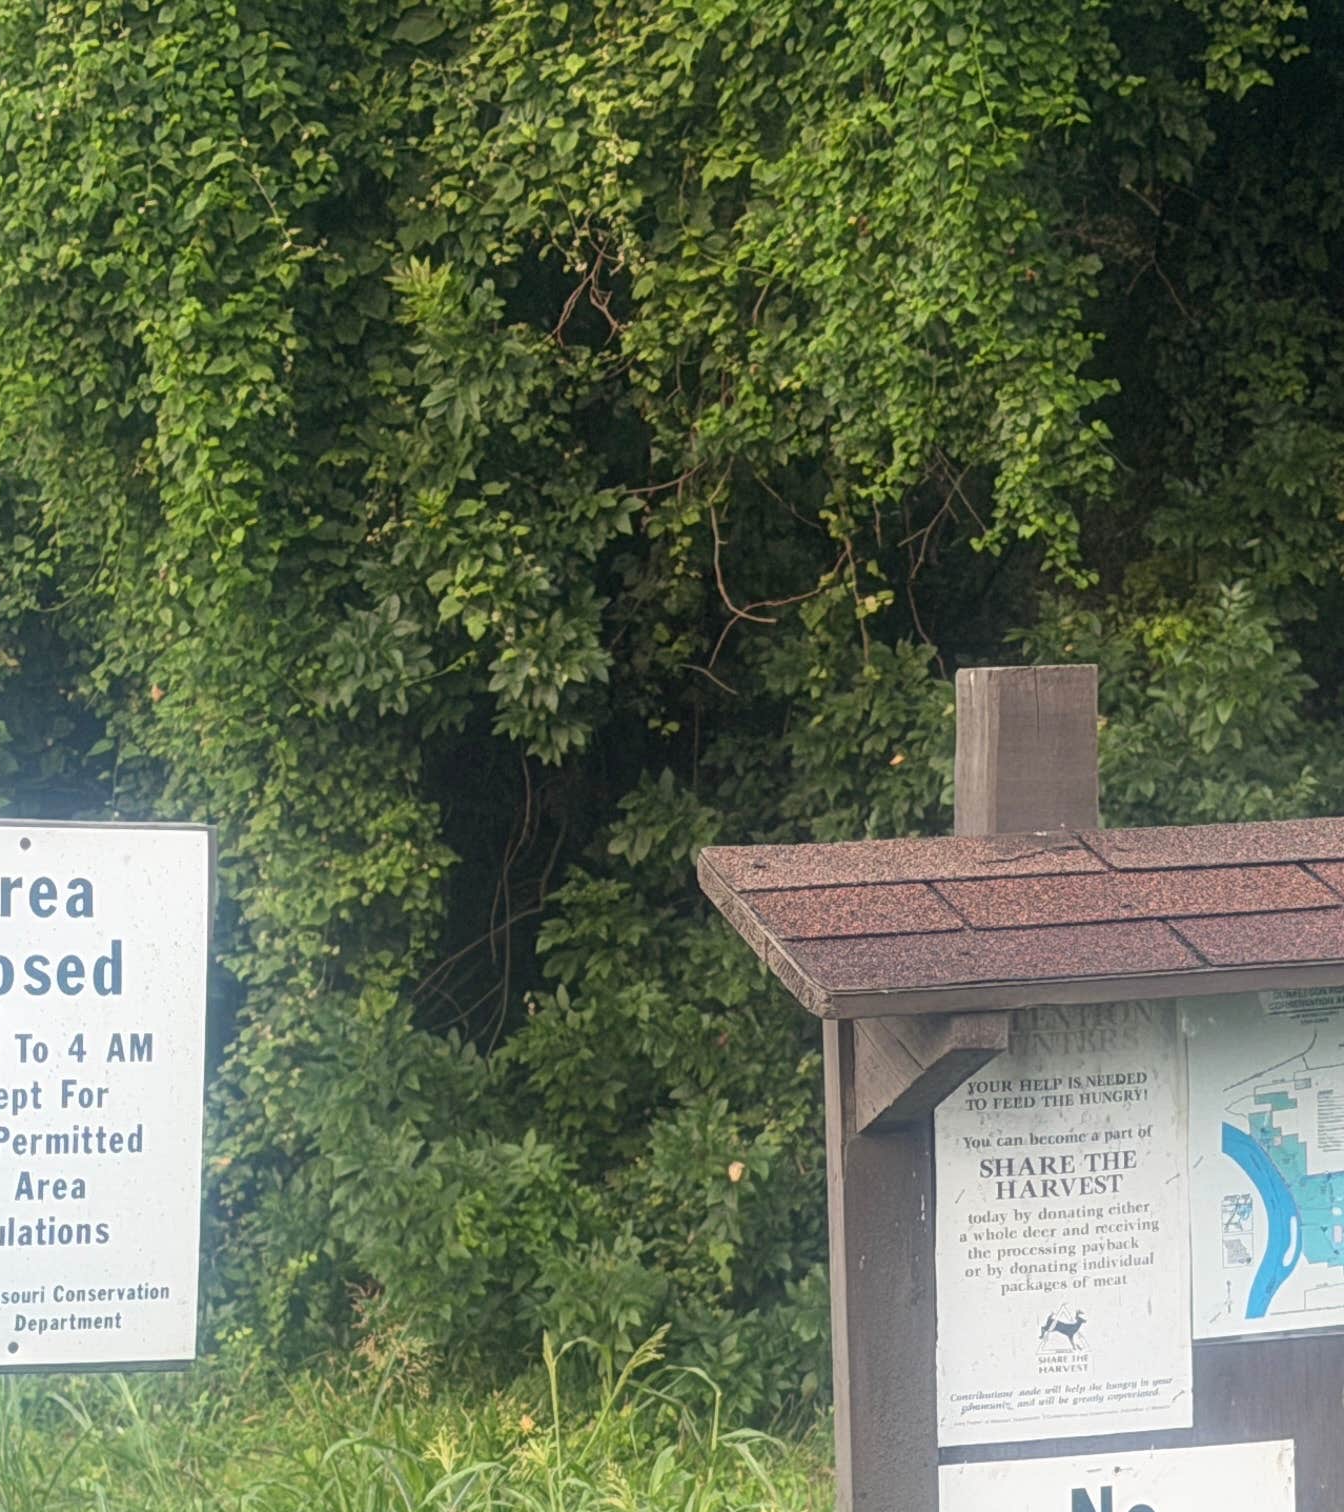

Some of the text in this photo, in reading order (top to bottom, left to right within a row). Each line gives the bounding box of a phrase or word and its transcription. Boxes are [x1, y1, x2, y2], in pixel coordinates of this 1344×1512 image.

[14, 1033, 49, 1064] To
[67, 1032, 87, 1064] 4
[106, 1032, 153, 1063] AM
[61, 1078, 110, 1109] For
[968, 1072, 1147, 1095] YOUR HELP IS NEEDED
[965, 1090, 1148, 1111] TO FEED THE HUNGRY!
[963, 1125, 1153, 1149] You can become a part of
[980, 1150, 1137, 1178] SHARE THE
[14, 1170, 86, 1201] Area
[996, 1174, 1123, 1200] HARVEST
[968, 1203, 1150, 1225] today by donating either
[960, 1220, 1159, 1242] a whole deer and receiving
[968, 1237, 1139, 1261] the processing payback
[965, 1252, 1154, 1278] or by donating individual
[52, 1282, 170, 1303] Conservation
[1001, 1275, 1127, 1295] packages of meat
[13, 1311, 122, 1336] Department
